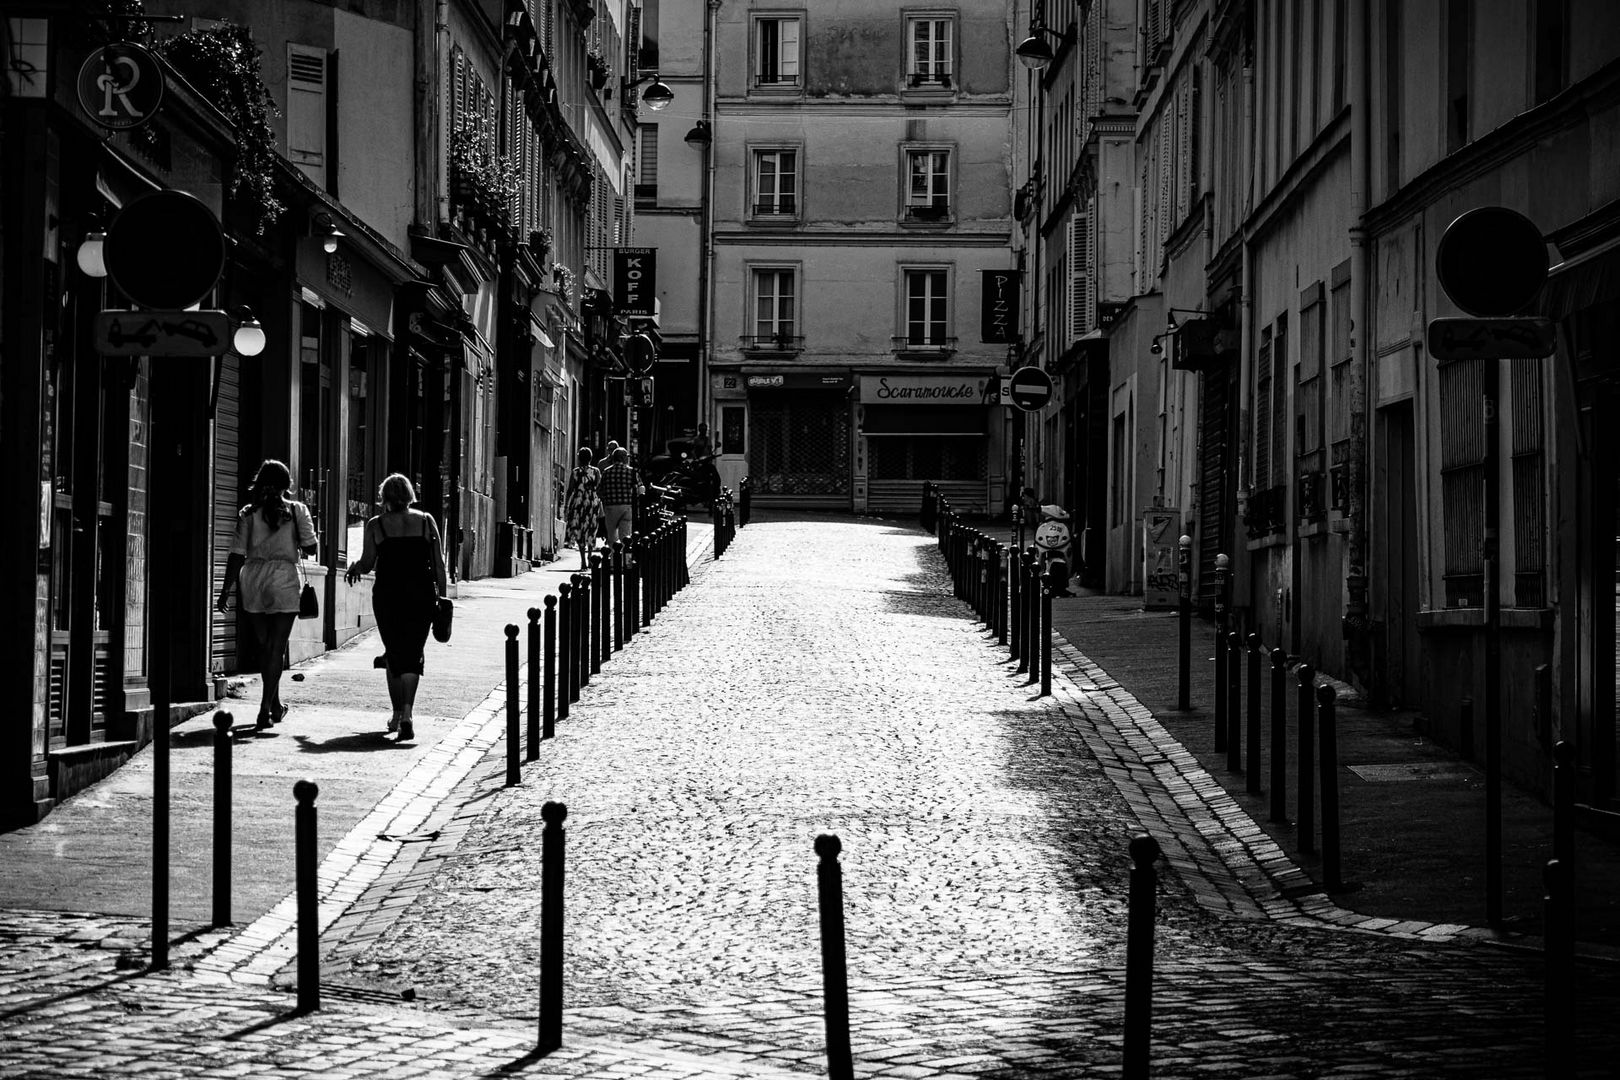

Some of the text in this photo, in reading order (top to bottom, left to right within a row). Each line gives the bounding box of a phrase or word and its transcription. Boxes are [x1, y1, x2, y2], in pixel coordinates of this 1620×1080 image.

[627, 258, 643, 304] KOFF
[993, 275, 1008, 339] PIZZA
[877, 377, 974, 399] Scaramouche
